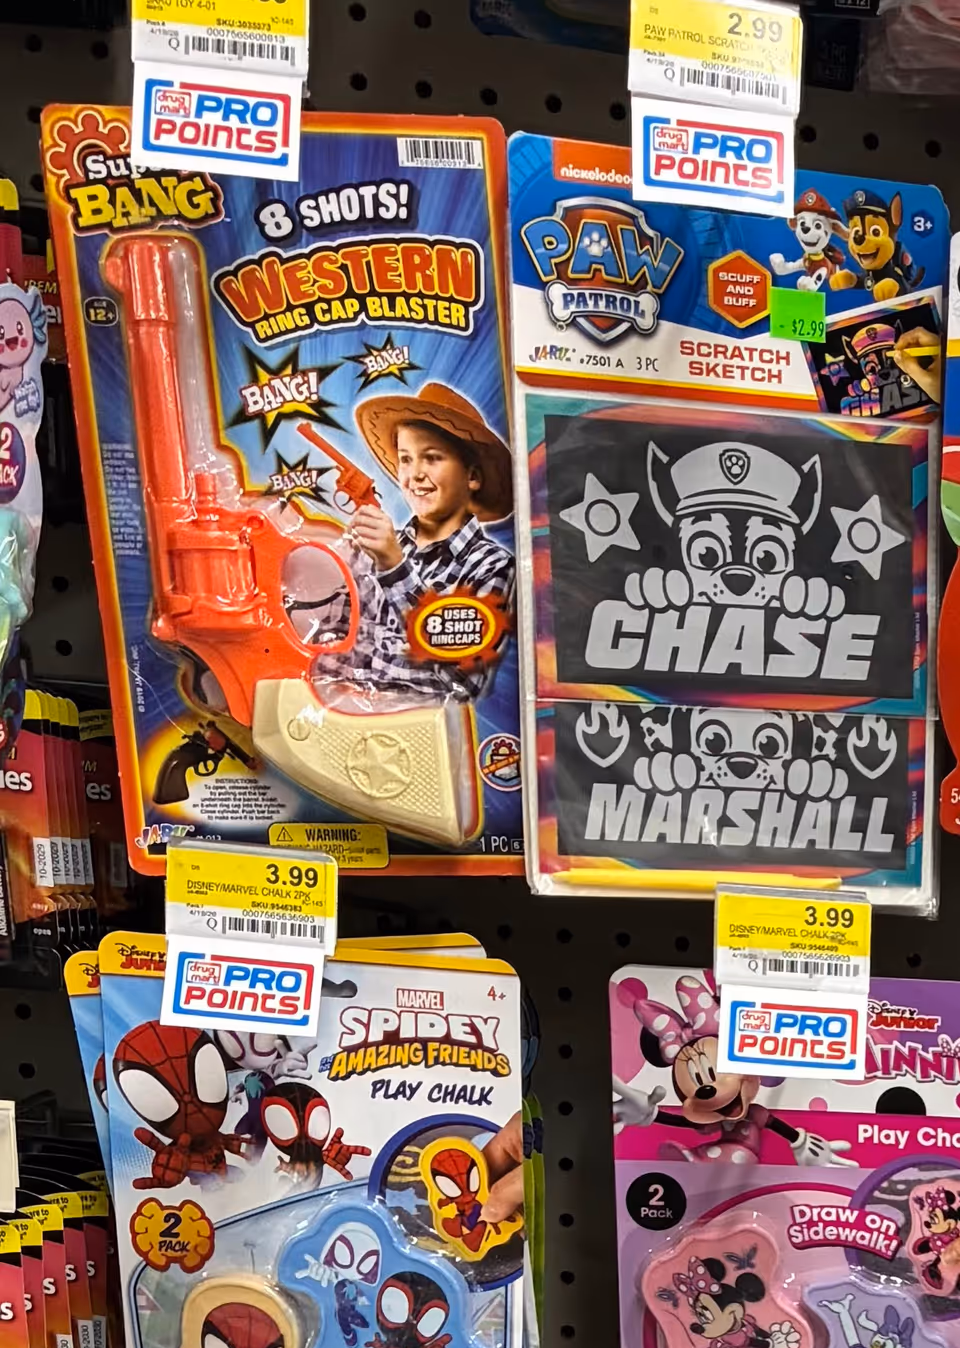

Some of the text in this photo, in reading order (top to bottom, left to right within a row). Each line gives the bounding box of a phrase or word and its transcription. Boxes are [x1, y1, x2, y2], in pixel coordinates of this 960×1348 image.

[728, 12, 783, 42] 2.99
[195, 95, 280, 124] PRO
[154, 121, 277, 154] POINTS
[693, 132, 772, 164] PRO
[655, 154, 772, 189] POINTS
[69, 177, 215, 228] BANG
[259, 184, 409, 235] 8 SHOTS!
[521, 216, 684, 293] PAW
[221, 244, 476, 323] WESTERN
[719, 272, 762, 285] SCUFF
[256, 297, 466, 338] RING CAP BLASTER
[562, 292, 647, 319] PATROL
[791, 318, 825, 338] $2.99
[364, 347, 410, 373] BANG!
[680, 340, 790, 367] SCRATCH
[688, 362, 783, 385] SKETCH
[242, 372, 318, 414] BANG!
[444, 608, 477, 620] USES
[445, 618, 483, 633] SHOT
[584, 599, 881, 681] CHASE
[585, 783, 895, 853] MARSHALL
[305, 828, 361, 844] WARNING:
[266, 862, 319, 887] 3.99
[187, 880, 290, 899] DISNEY/MARVEL CHALK
[804, 905, 855, 928] 3.99
[224, 965, 301, 991] PRO
[184, 987, 298, 1016] POINTS
[397, 988, 444, 1011] MARVEL
[340, 1007, 500, 1050] SPIDEY
[774, 1012, 847, 1038] PRO
[329, 1042, 511, 1079] AMAZING FRIENDS
[738, 1034, 847, 1060] POINTS
[372, 1080, 493, 1106] PLAY CHALK
[858, 1124, 910, 1150] Play
[649, 1184, 665, 1206] 2
[640, 1206, 673, 1219] Pack
[793, 1205, 897, 1233] Draw on
[162, 1213, 181, 1240] 2
[788, 1223, 898, 1255] Sidewalk!
[158, 1238, 191, 1255] PACK
